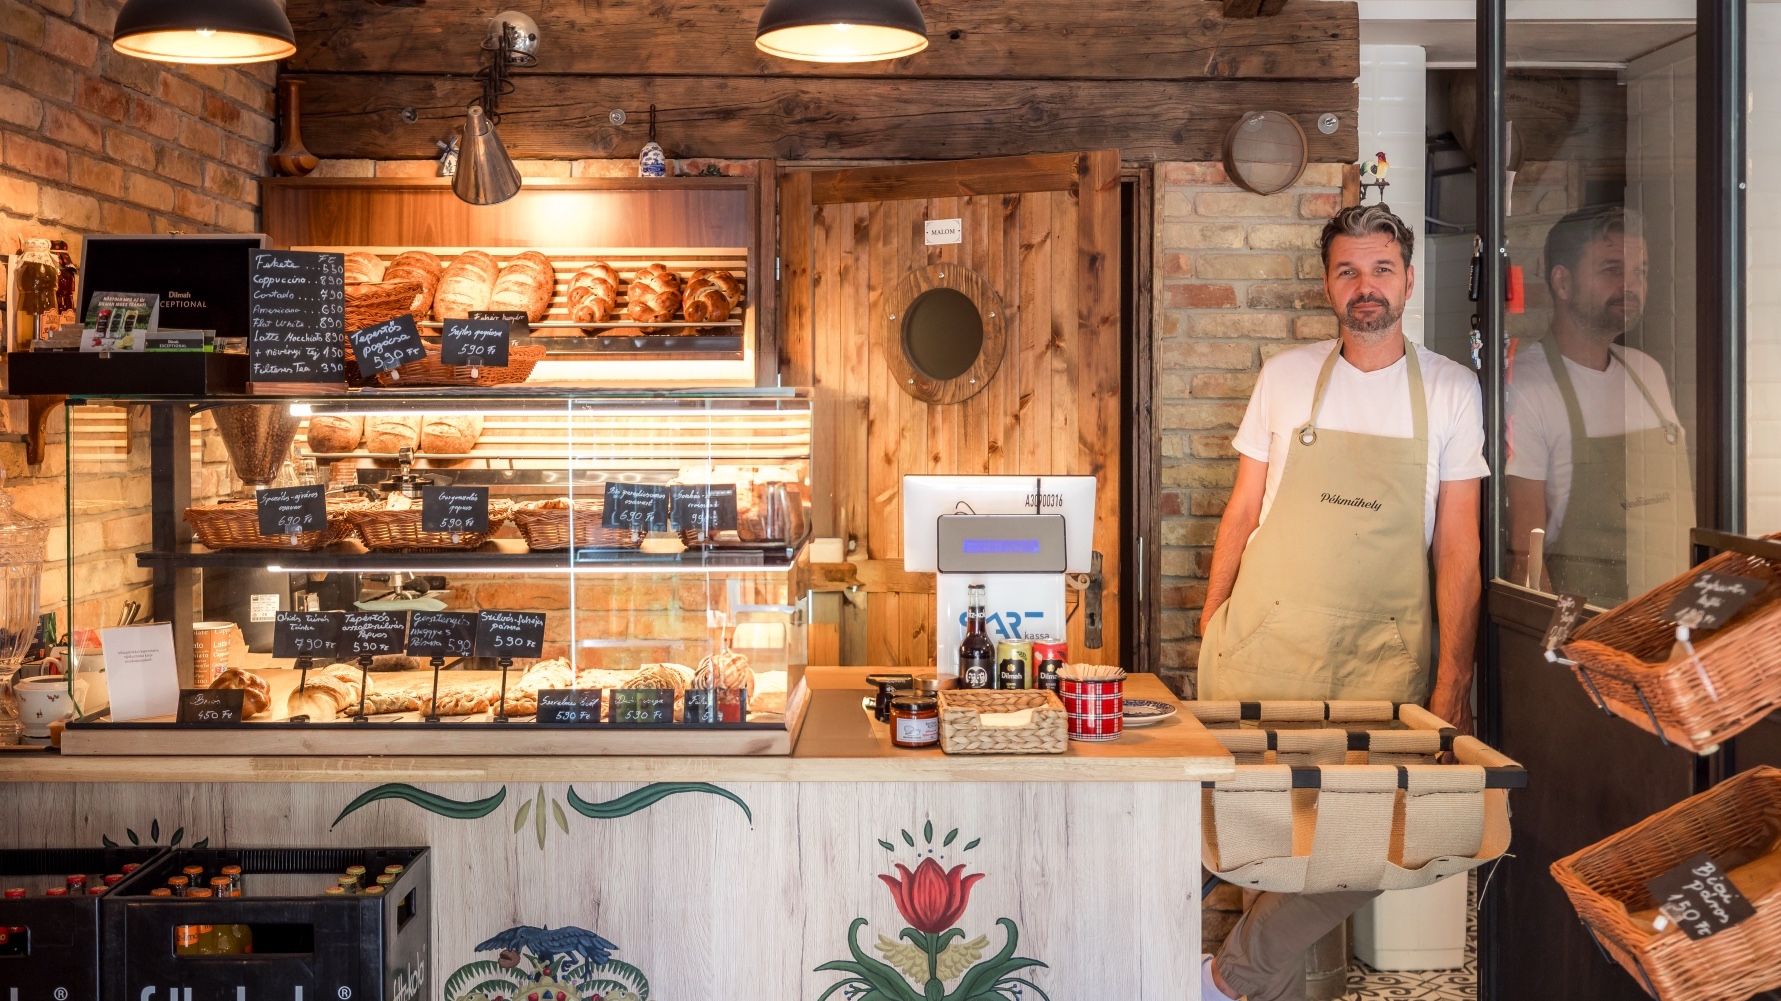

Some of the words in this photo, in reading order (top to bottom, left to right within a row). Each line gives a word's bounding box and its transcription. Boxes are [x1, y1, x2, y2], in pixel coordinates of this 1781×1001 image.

[255, 254, 300, 270] Fekete
[252, 274, 306, 289] Cappuccino
[320, 275, 343, 286] 890
[168, 291, 191, 299] Dilmah
[320, 289, 343, 300] 790
[159, 300, 207, 308] CEPTIONAL
[252, 304, 301, 315] Americano
[321, 304, 343, 315] 650
[319, 317, 343, 329] 890
[324, 332, 344, 342] 890
[457, 343, 485, 355] 590
[487, 345, 497, 355] Ft
[373, 350, 404, 370] 590
[320, 362, 344, 373] 390
[1320, 492, 1382, 512] Pékműhely
[278, 515, 301, 526] 690
[619, 510, 643, 522] 690
[440, 517, 463, 528] 590
[493, 635, 524, 647] 590
[1024, 632, 1050, 640] kassa
[294, 638, 323, 651] 790
[353, 641, 378, 652] 590
[447, 638, 471, 653] 590
[1001, 671, 1023, 680] Dilmah
[198, 710, 219, 720] 450
[221, 709, 233, 719] Ft
